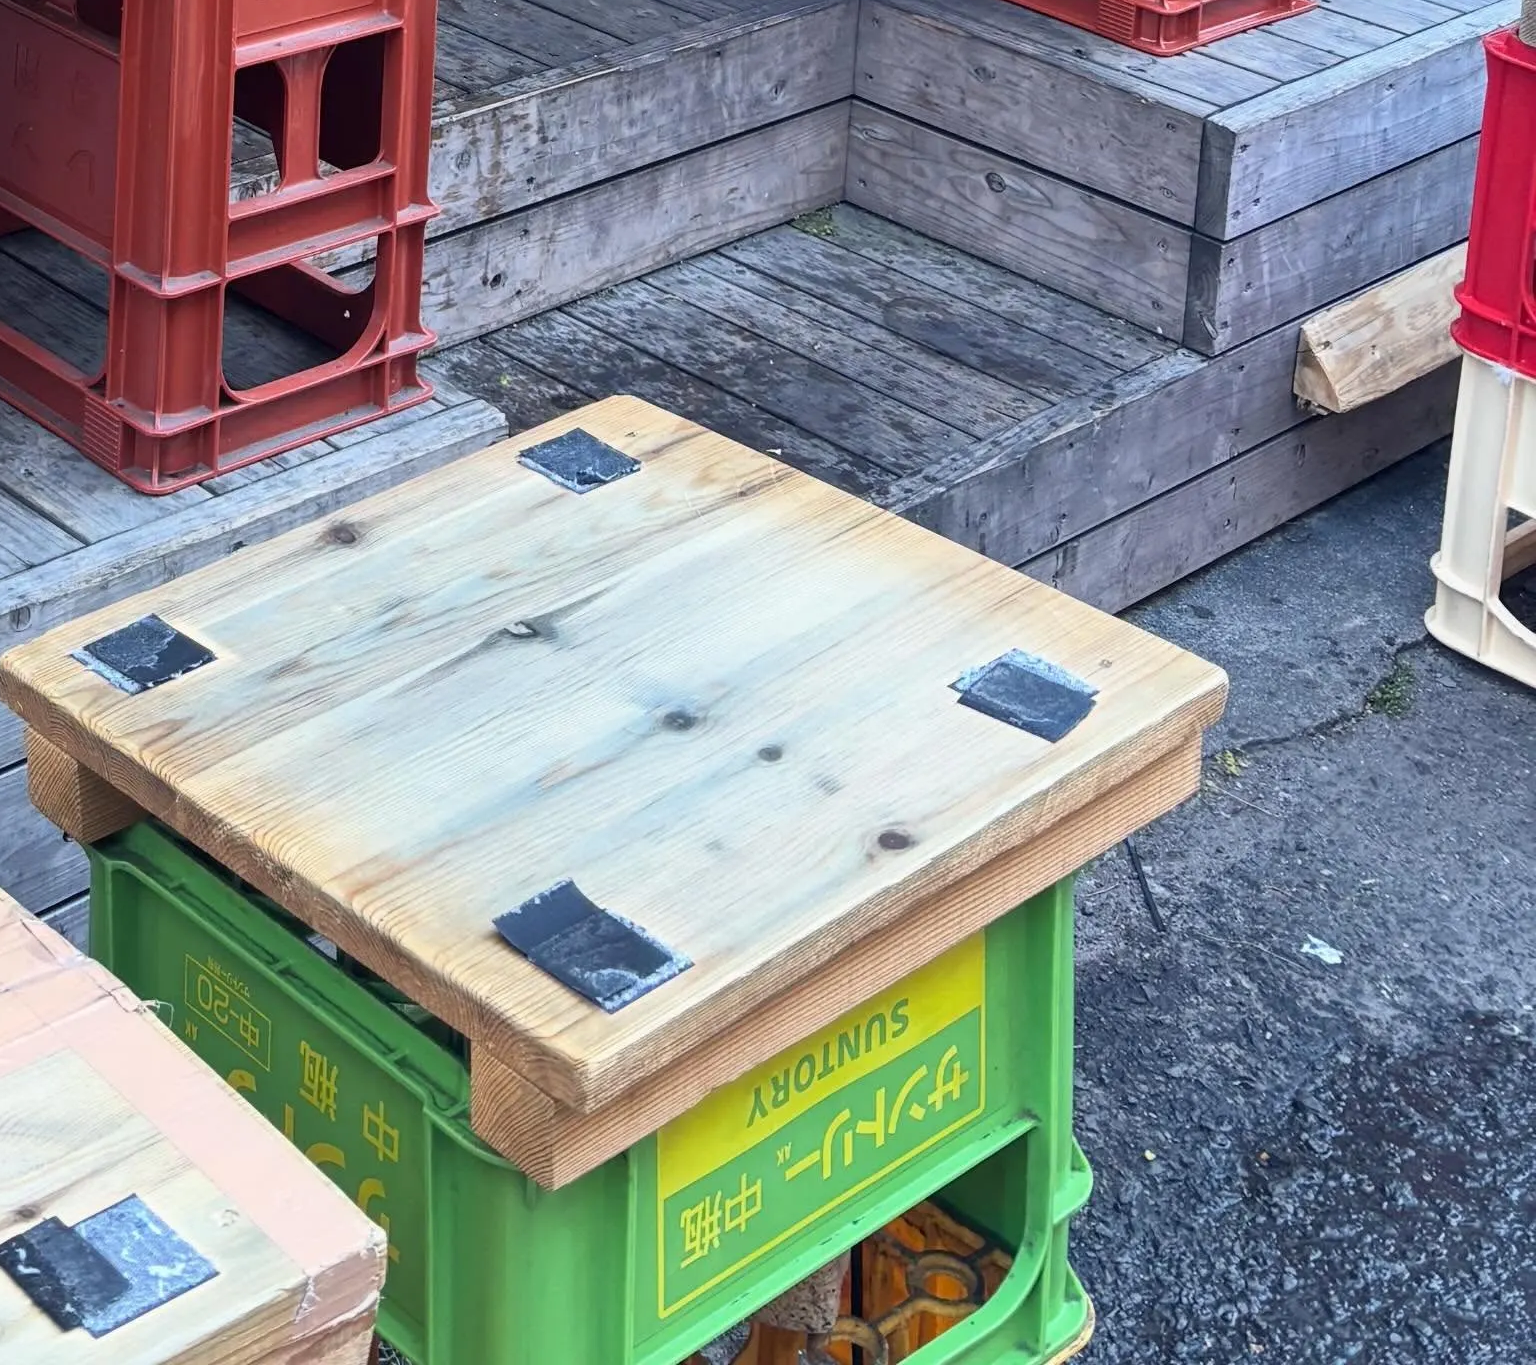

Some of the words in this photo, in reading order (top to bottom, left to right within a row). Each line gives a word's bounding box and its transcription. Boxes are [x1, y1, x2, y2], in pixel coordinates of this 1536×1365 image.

[298, 1039, 400, 1162] 中瓶
[746, 998, 909, 1128] SUNTORY
[784, 1044, 970, 1182] サントリー
[679, 1172, 763, 1269] 中瓶
